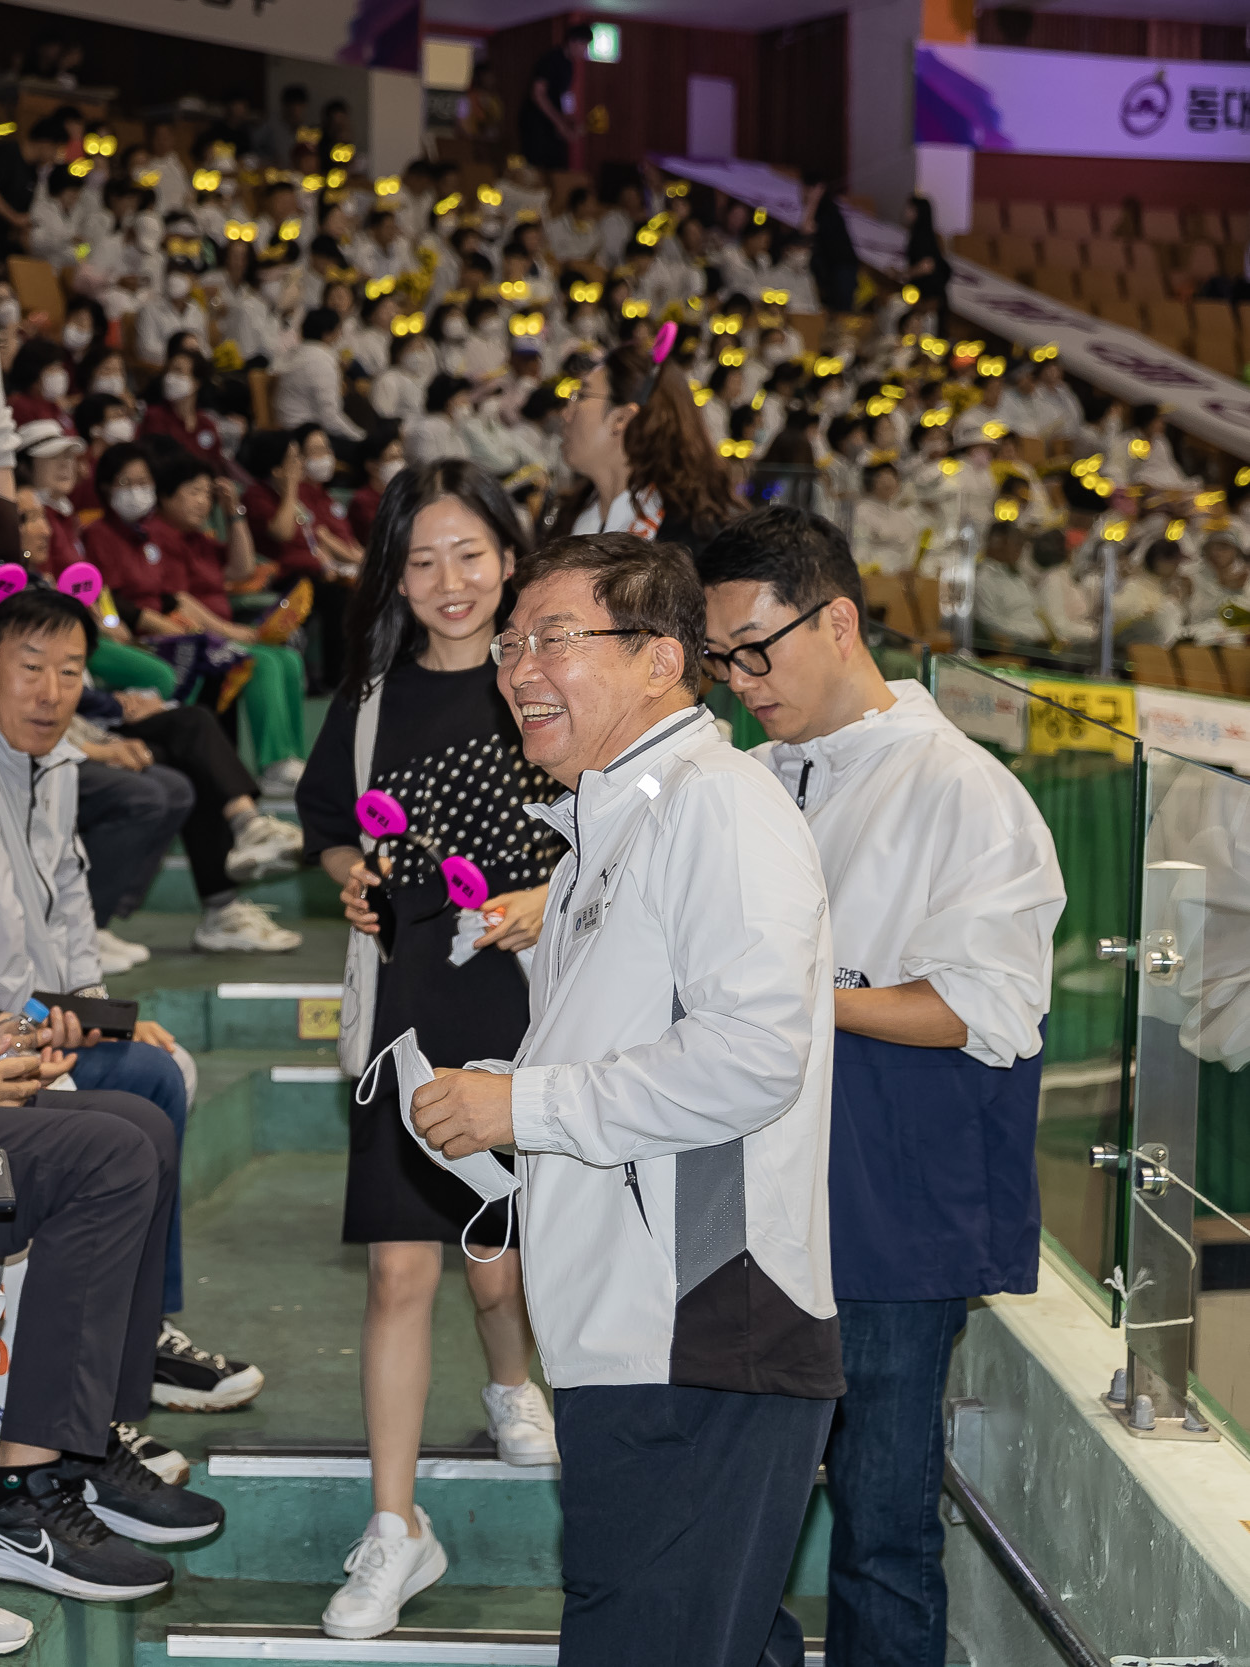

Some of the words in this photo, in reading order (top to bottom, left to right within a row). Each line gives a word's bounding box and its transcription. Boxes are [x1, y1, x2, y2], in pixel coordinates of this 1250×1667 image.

[366, 804, 390, 829] 광진
[451, 873, 475, 899] 광진
[838, 966, 861, 980] THE
